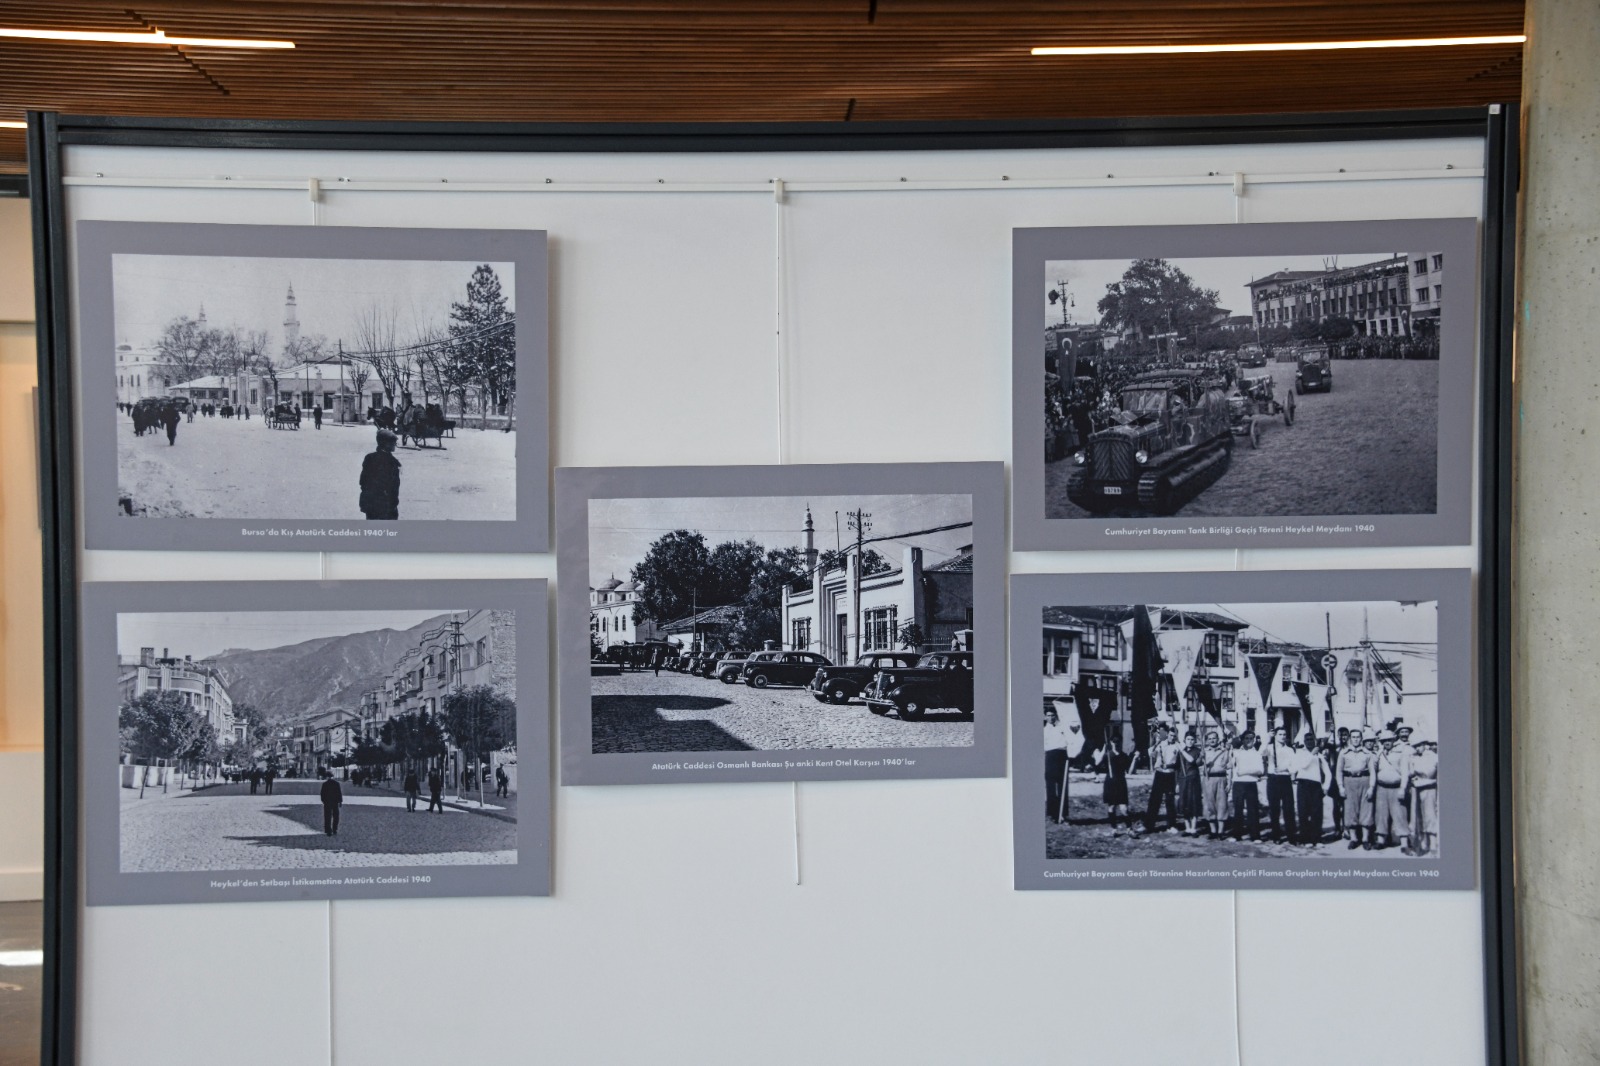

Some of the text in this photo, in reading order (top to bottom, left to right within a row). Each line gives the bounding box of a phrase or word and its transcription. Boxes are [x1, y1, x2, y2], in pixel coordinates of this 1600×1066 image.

[242, 528, 279, 536] Bursa'da
[281, 528, 293, 538] Kış
[296, 528, 326, 536] Atatürk
[1105, 528, 1150, 536] Cumhuriyet
[1153, 528, 1186, 536] Bayramı
[1209, 527, 1232, 535] Birliği
[1286, 525, 1314, 534] Heykel
[1316, 525, 1352, 534] Meydanı
[652, 762, 681, 770] Atatürk
[717, 761, 749, 769] Osmanlı
[785, 760, 794, 769] Şu
[1044, 870, 1089, 879] Cumhuriyet
[1091, 870, 1124, 879] Bayramı
[1149, 869, 1183, 877] Törenine
[1232, 869, 1256, 878] Çeşitli
[1285, 870, 1319, 878] Grupları
[1322, 870, 1350, 878] Heykel
[1353, 869, 1389, 878] Meydanı
[292, 877, 342, 886] İstikametine
[377, 876, 409, 884] Caddesi
